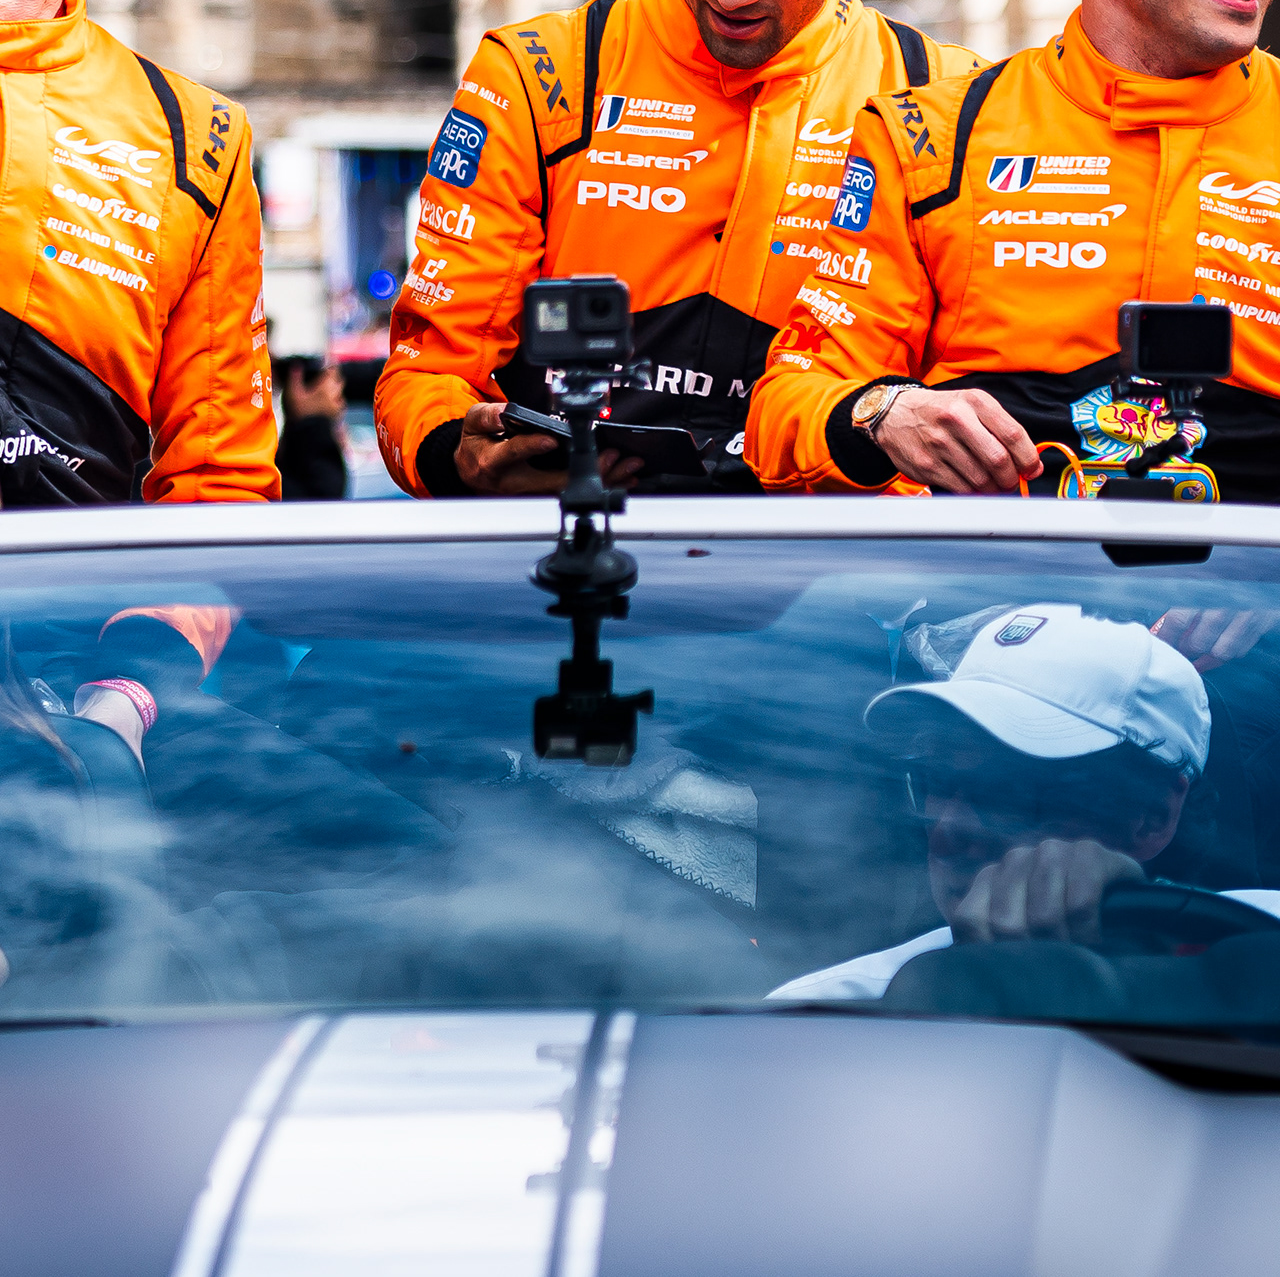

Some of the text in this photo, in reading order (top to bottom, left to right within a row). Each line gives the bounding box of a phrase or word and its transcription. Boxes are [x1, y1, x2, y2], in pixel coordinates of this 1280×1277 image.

[516, 30, 570, 114] HRX
[477, 86, 510, 111] MILLE
[627, 97, 696, 116] UNITED
[625, 108, 693, 123] AUTOSPORTS
[891, 89, 938, 159] HRX
[442, 122, 480, 149] AERO
[623, 126, 649, 134] RACING
[650, 128, 681, 137] PARTNER
[53, 147, 69, 158] FIA
[794, 154, 846, 165] CHAMPIONS
[795, 146, 843, 158] FIA WORLD
[1037, 167, 1108, 176] AUTOSPORTS
[1039, 156, 1111, 168] UNITED
[843, 169, 873, 191] ERO
[577, 180, 686, 213] PRIO
[785, 182, 841, 200] GOOD
[52, 183, 160, 232] GOODYEAR
[1199, 195, 1214, 205] FIA
[1216, 199, 1248, 214] WORLD
[1200, 204, 1268, 224] CHAMPIONSHIP
[776, 215, 830, 231] RICHA
[978, 210, 1110, 227] McLaren
[46, 216, 156, 265] RICHARD MILLE
[994, 241, 1107, 269] PRIO
[57, 249, 149, 292] BLAUPUNKT
[1195, 266, 1262, 291] RICHARD
[411, 290, 438, 307] FLEET
[810, 307, 839, 327] FLEET
